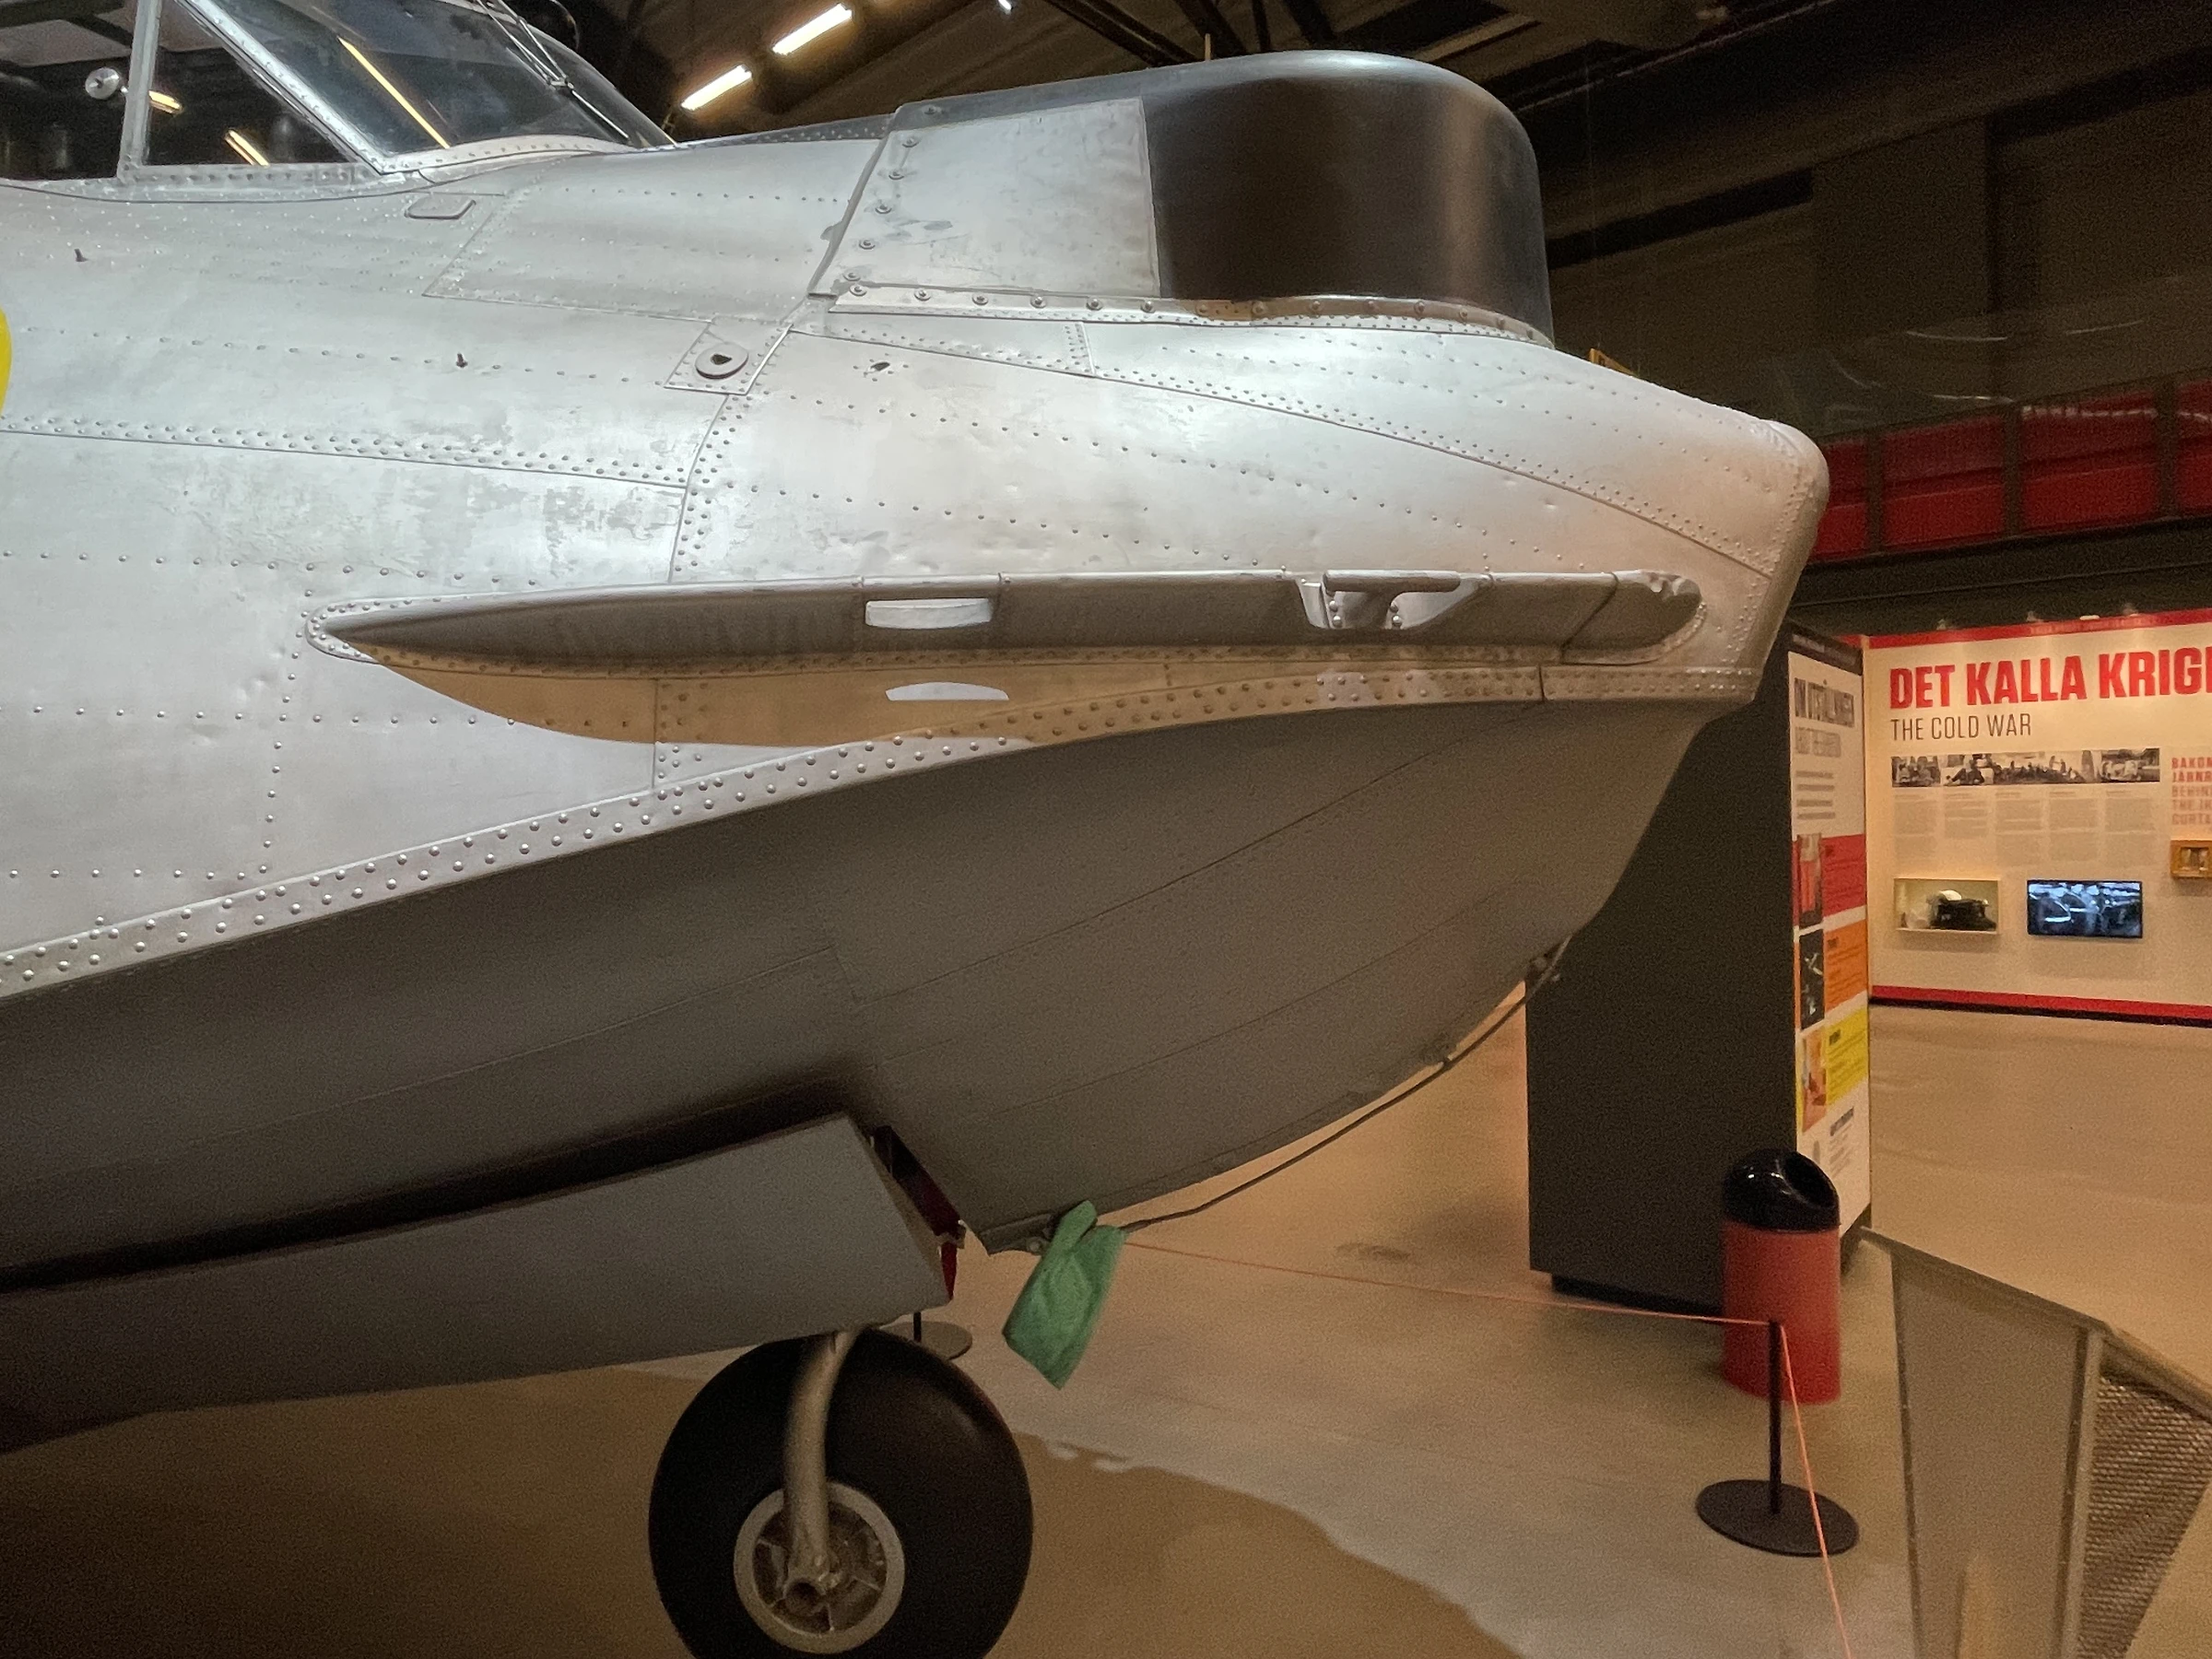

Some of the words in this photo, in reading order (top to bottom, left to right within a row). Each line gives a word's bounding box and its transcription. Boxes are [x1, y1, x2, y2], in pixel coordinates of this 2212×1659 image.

[1890, 665, 1955, 709] DET
[1966, 655, 2088, 706] KALLA
[1890, 718, 1924, 741] THE
[1932, 715, 1979, 740] COLD
[1987, 712, 2031, 736] WAR
[2171, 785, 2212, 797] BEHIN
